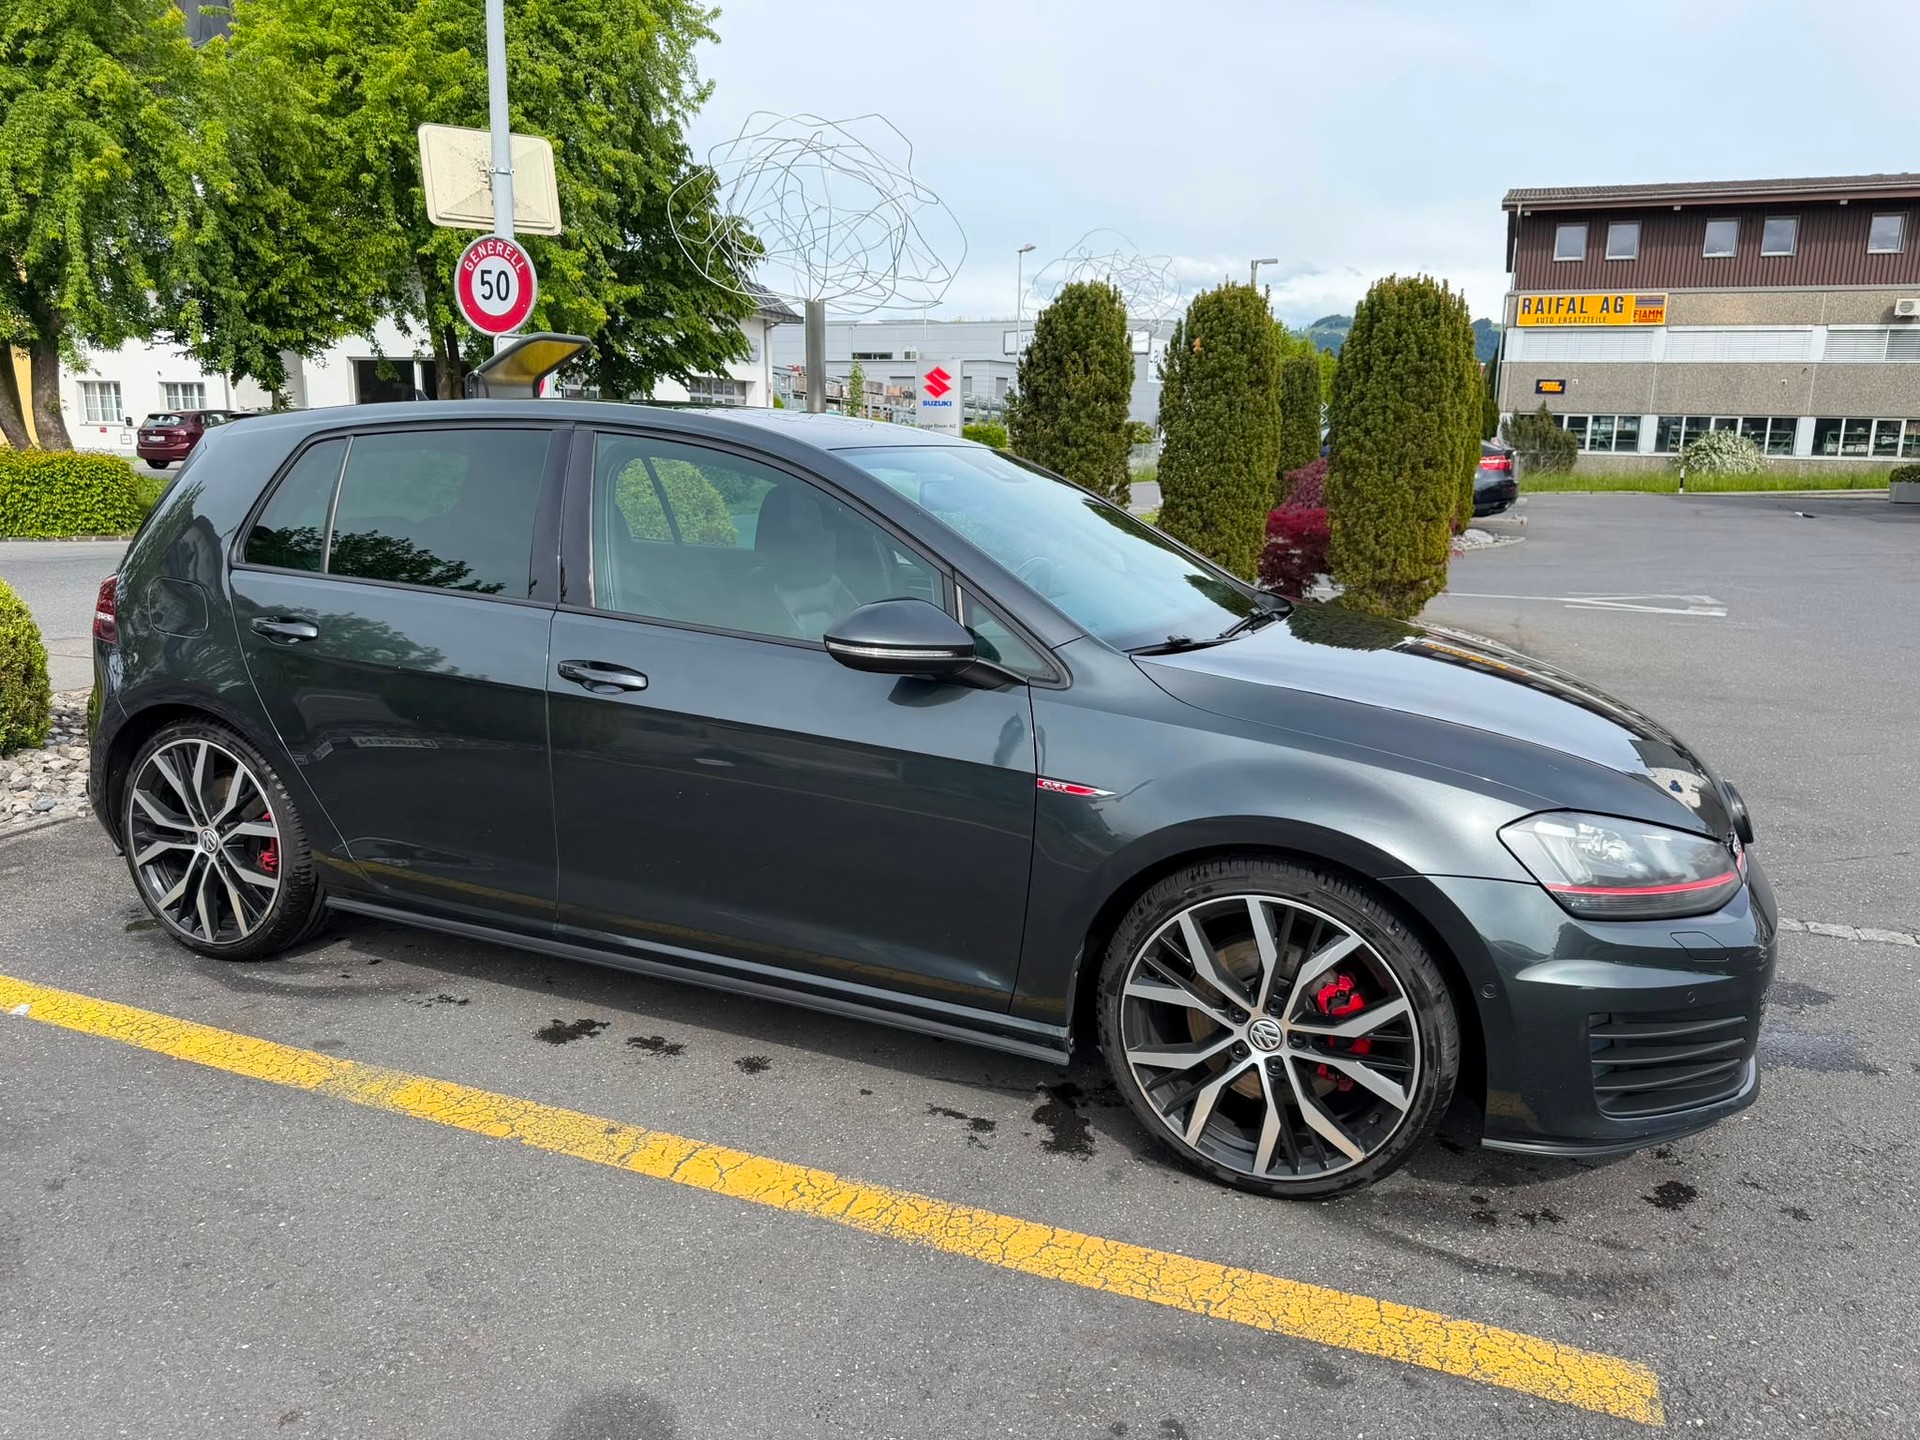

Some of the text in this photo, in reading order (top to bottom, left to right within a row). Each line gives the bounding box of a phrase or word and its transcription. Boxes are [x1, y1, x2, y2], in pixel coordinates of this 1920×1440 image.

[464, 241, 524, 273] GENERELL
[480, 269, 510, 301] 50
[1522, 295, 1624, 315] RAIFAL AG
[1633, 309, 1663, 319] FIAMM
[1535, 315, 1607, 324] AUTO ERSATZTEILE
